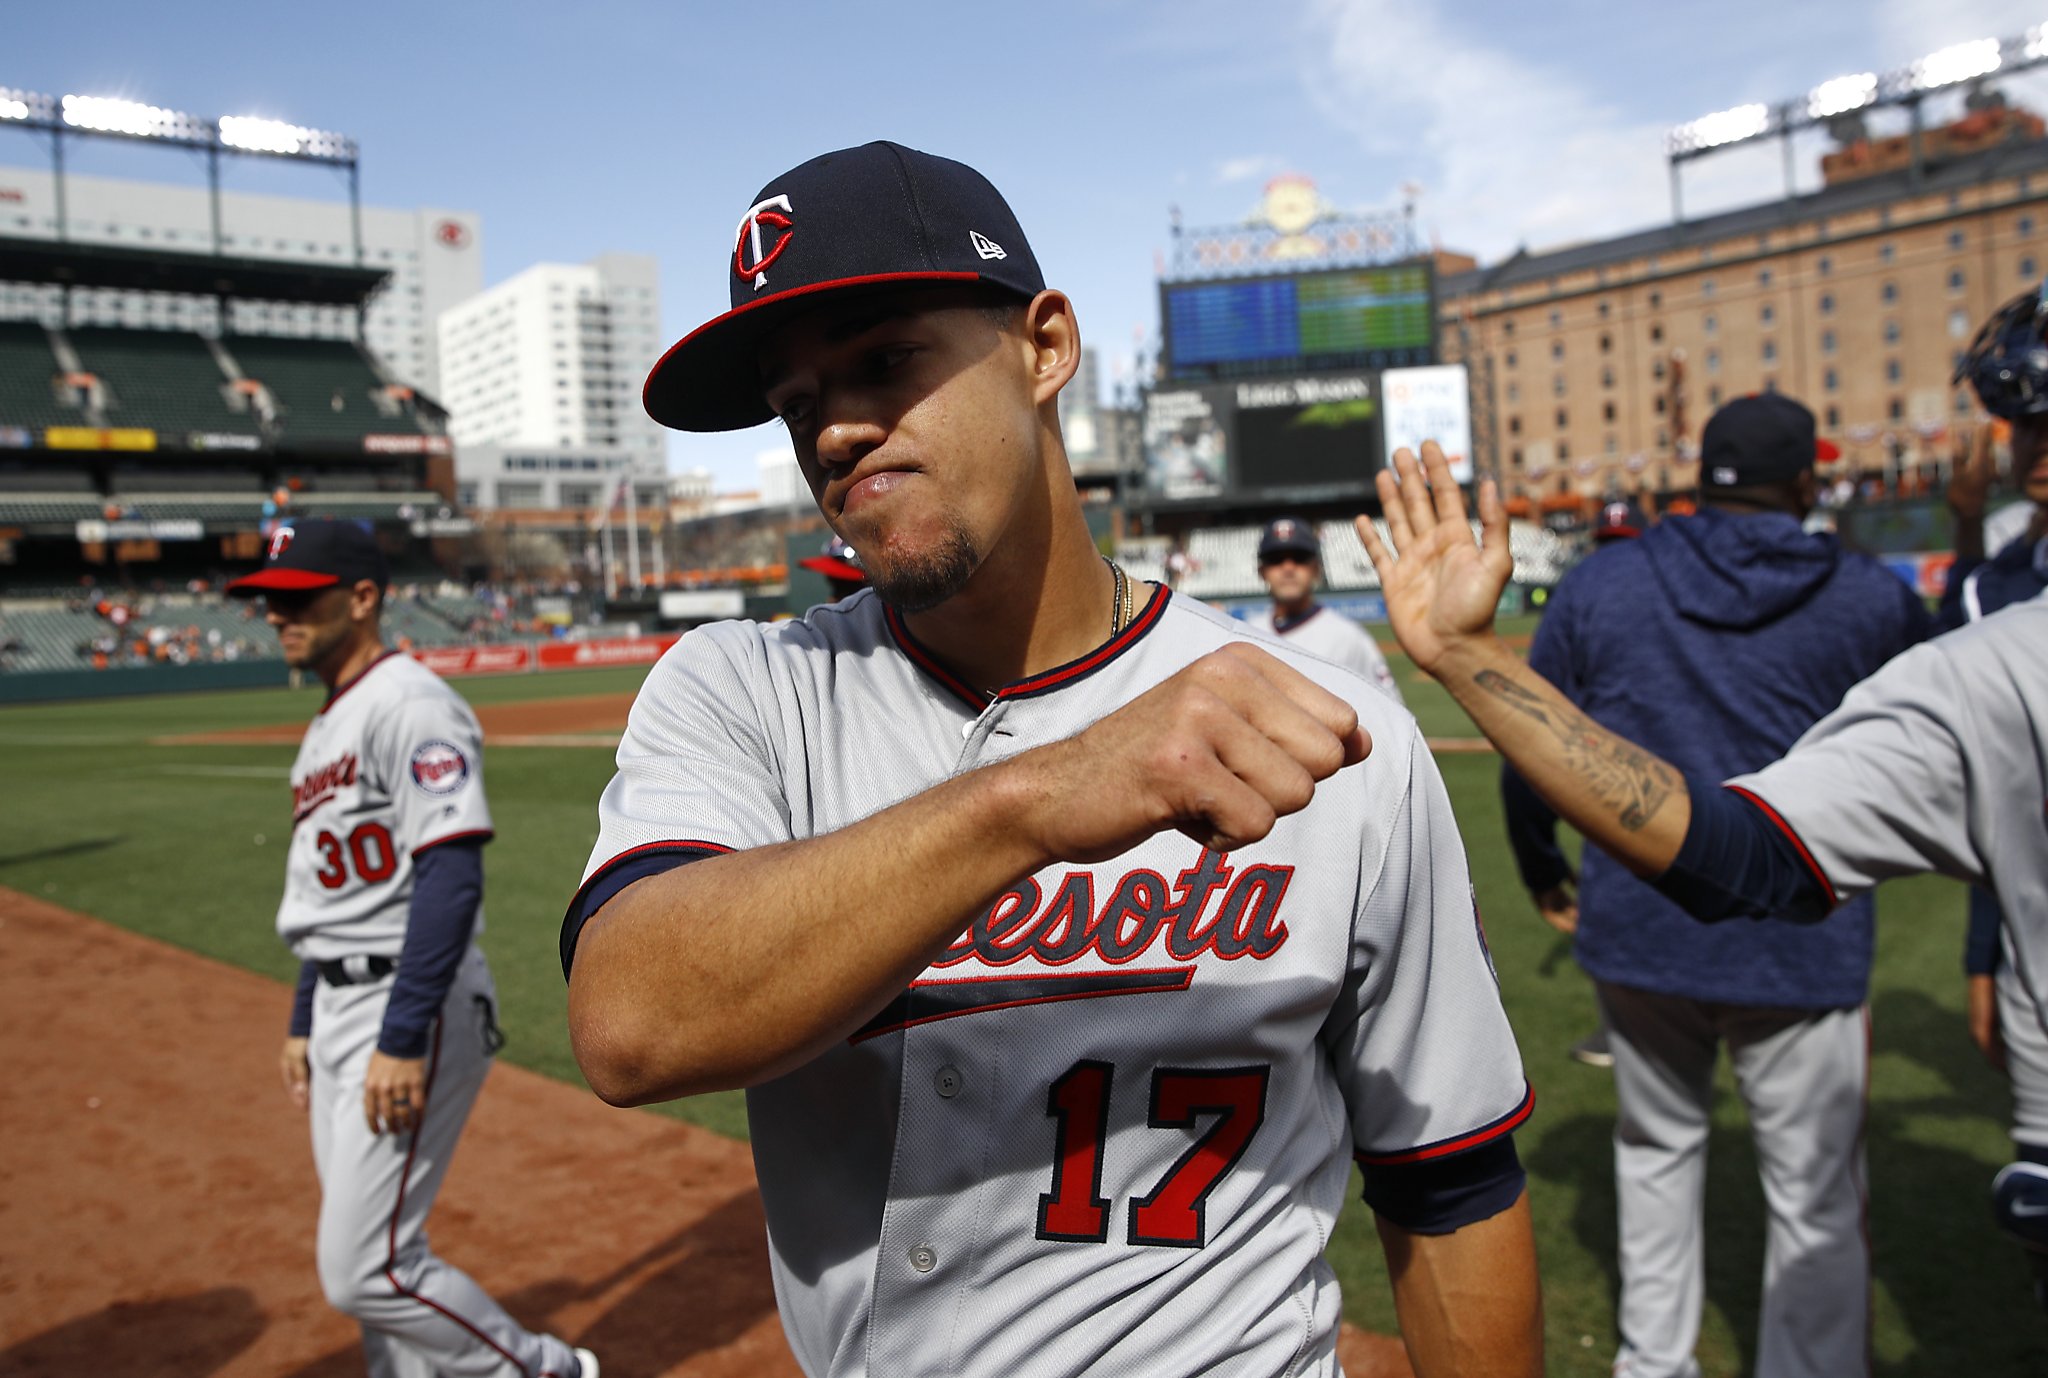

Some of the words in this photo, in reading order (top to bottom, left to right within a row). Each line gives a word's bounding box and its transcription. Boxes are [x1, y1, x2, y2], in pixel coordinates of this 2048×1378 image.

[317, 821, 398, 890] 30
[930, 847, 1296, 967] esota
[1034, 1057, 1271, 1250] 17
